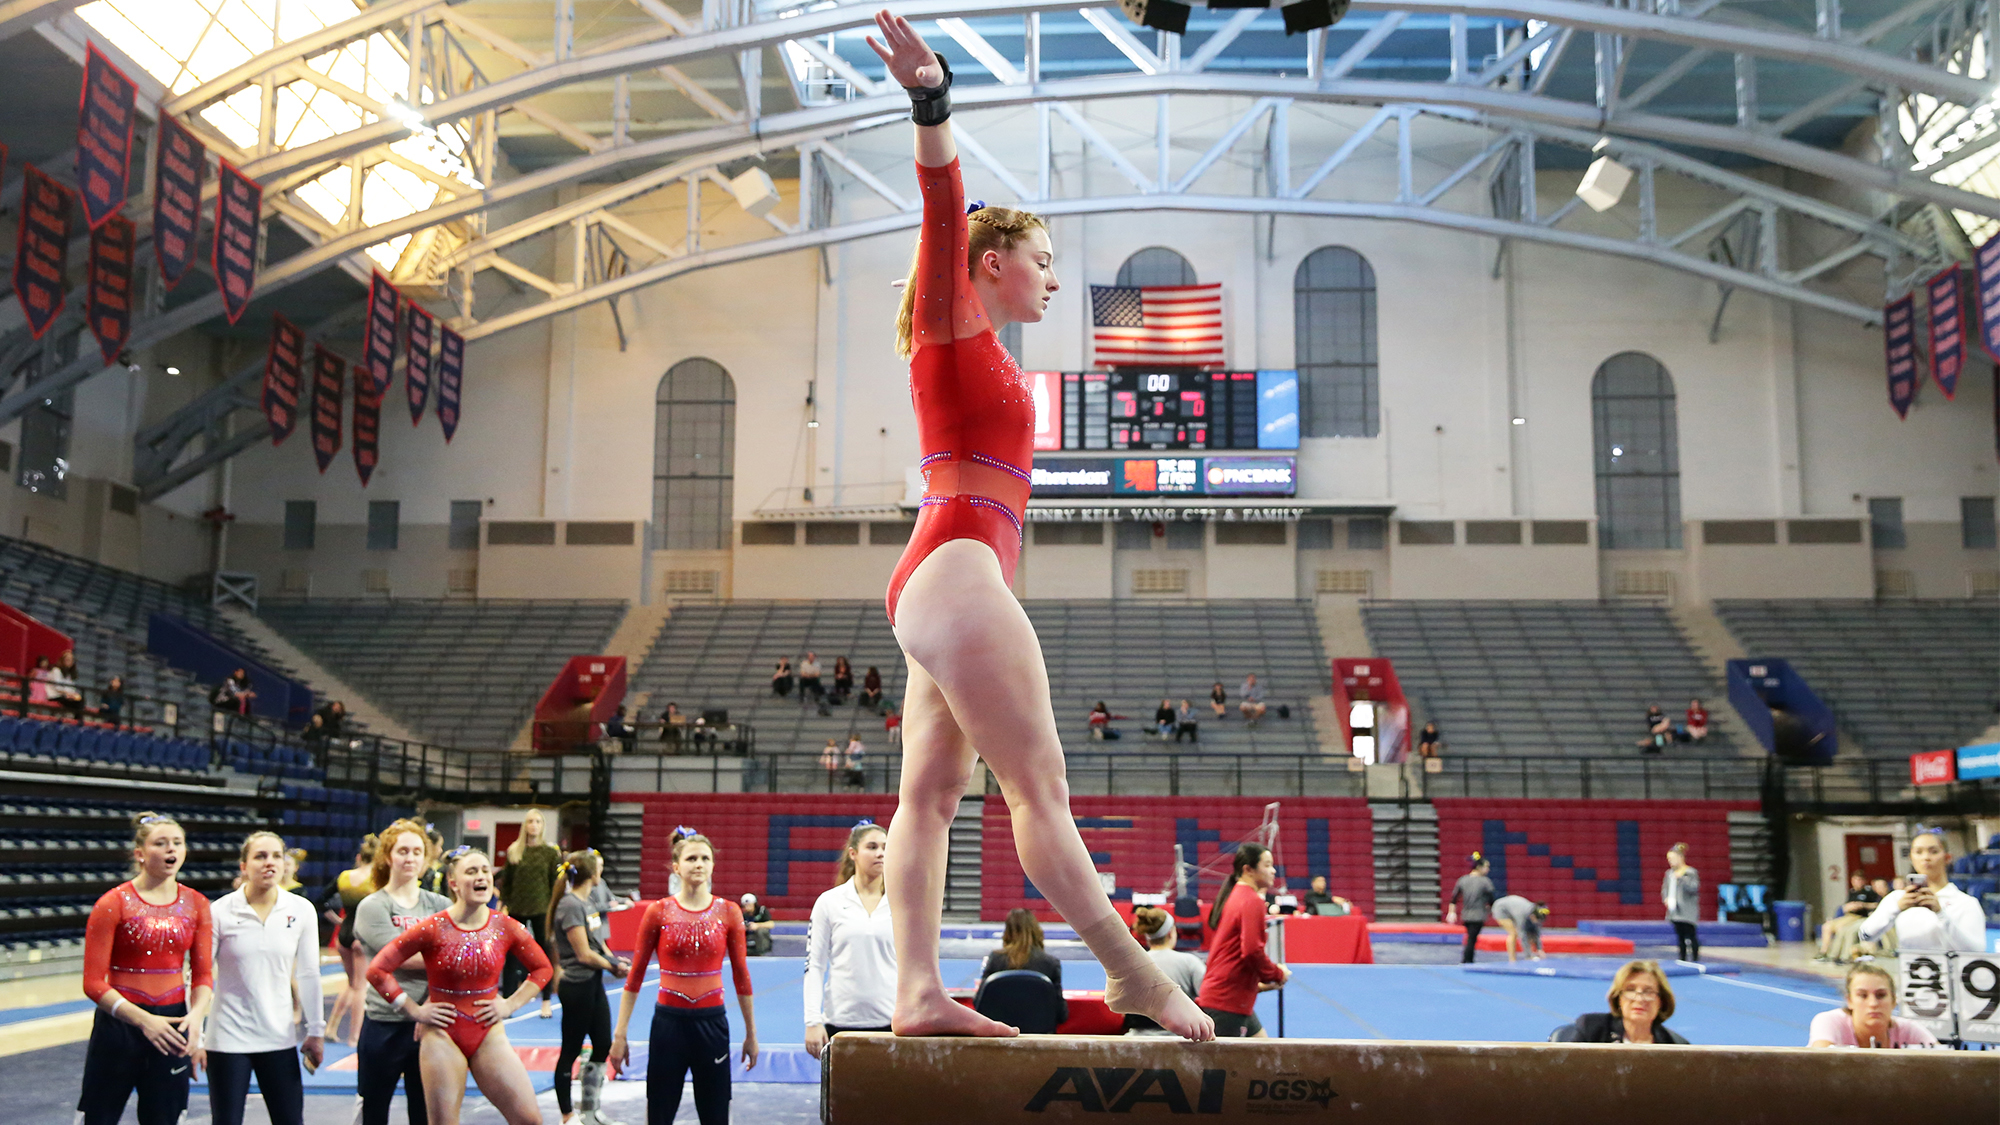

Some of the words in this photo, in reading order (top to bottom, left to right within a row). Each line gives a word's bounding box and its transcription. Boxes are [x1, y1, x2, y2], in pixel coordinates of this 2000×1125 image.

[1147, 374, 1170, 392] 00
[1193, 400, 1205, 417] 0
[1081, 508, 1121, 522] KELL
[1223, 508, 1235, 522] &
[1243, 508, 1304, 522] FAMILY
[286, 915, 296, 928] P
[1961, 960, 2000, 1020] 9
[1247, 1079, 1307, 1101] DGS
